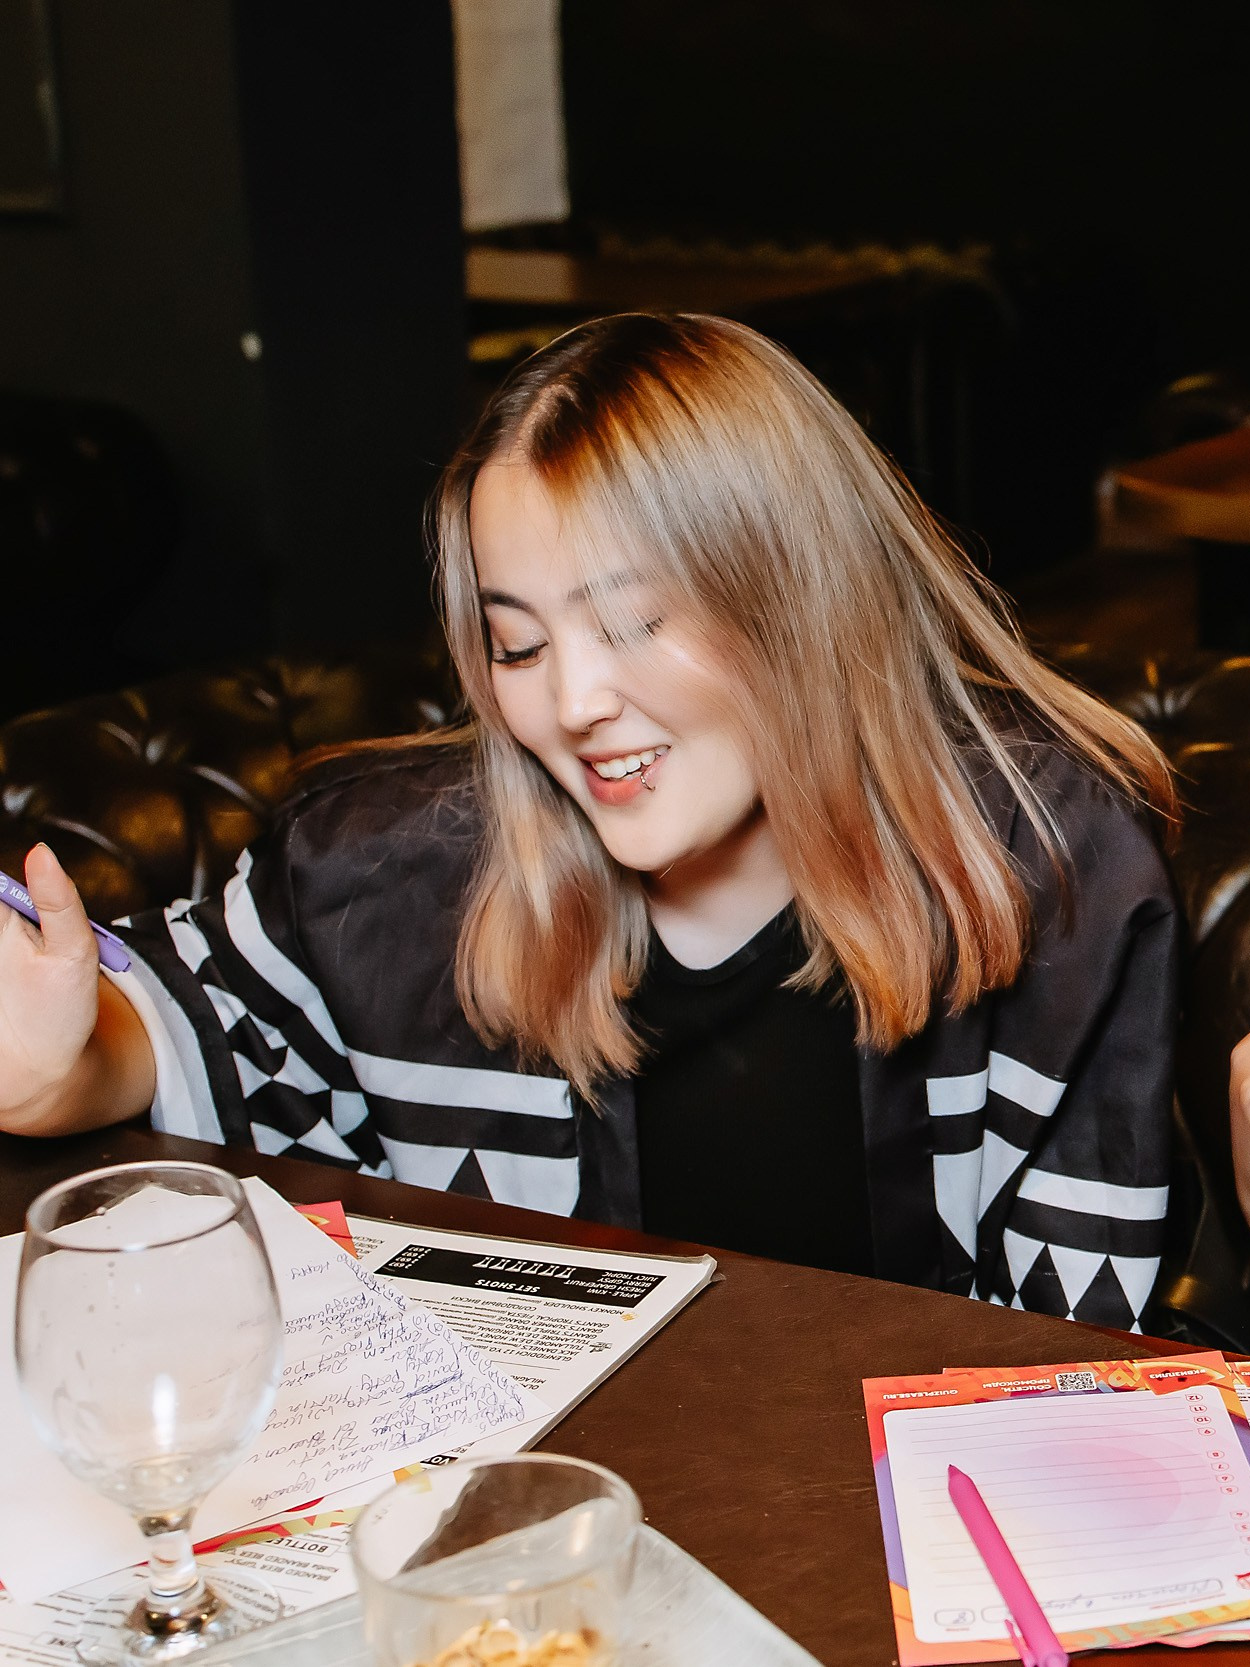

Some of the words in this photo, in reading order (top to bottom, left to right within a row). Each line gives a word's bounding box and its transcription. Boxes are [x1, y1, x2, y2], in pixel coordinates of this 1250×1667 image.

[475, 1279, 515, 1290] SHOTS
[563, 1279, 617, 1290] GRAPEFRUIT
[622, 1280, 652, 1288] BERRY
[515, 1285, 540, 1293] SET
[617, 1285, 646, 1293] FRESH
[613, 1291, 641, 1299] APPLE
[450, 1296, 483, 1305] ВИСКИ
[483, 1301, 538, 1312] СОЛОДОВЫЙ
[543, 1301, 590, 1312] SHOULDER
[507, 1312, 535, 1320] FIESTA
[589, 1307, 625, 1316] MONKEY
[496, 1316, 530, 1325] ORANGE
[535, 1315, 576, 1325] TROPICAL
[505, 1324, 532, 1332] WOOD
[531, 1321, 569, 1330] SUMMER
[477, 1326, 516, 1335] ORIGINAL
[534, 1327, 563, 1335] TRIPLE
[479, 1333, 508, 1341] HONEY
[540, 1335, 591, 1345] TULLAMORE
[534, 1340, 585, 1351] TULLAMORE
[516, 1351, 573, 1362] GLENFIDDICH
[982, 1379, 1050, 1389] ПРОМОКОДЫ
[882, 1389, 958, 1400] QUIZPLEASE.RU
[260, 1564, 284, 1573] BEER
[285, 1569, 331, 1581] BRANDED
